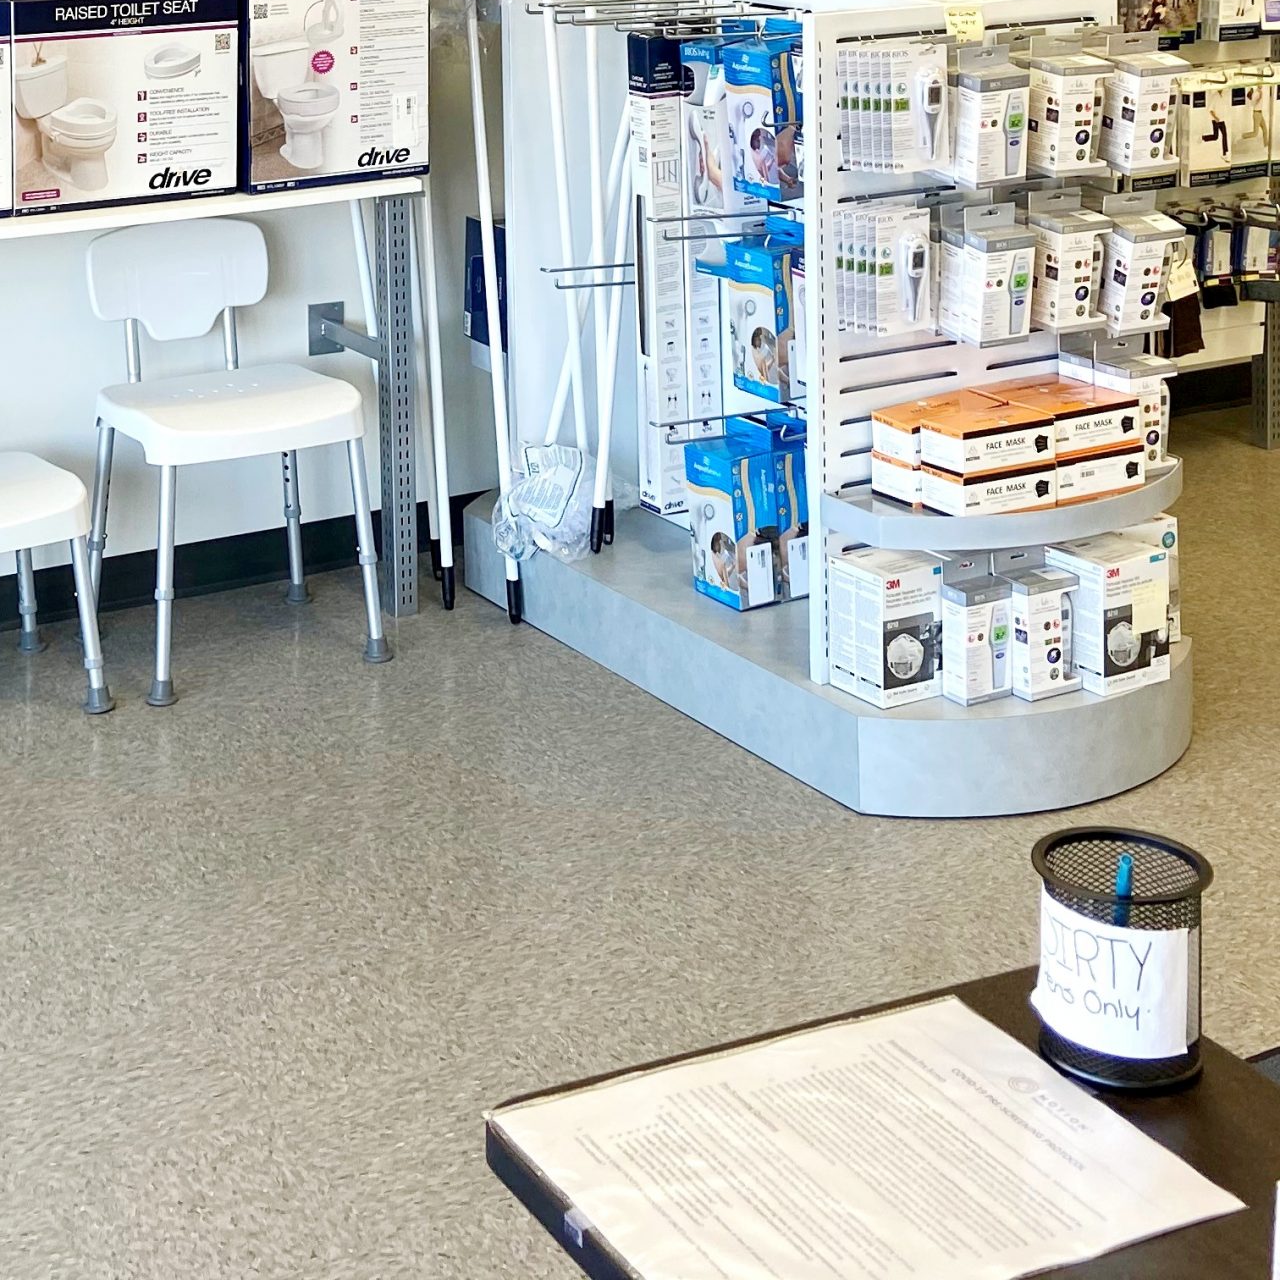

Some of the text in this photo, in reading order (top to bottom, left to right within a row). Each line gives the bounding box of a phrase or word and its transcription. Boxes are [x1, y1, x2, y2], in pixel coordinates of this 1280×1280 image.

[56, 0, 198, 21] RAISED TOILET SEAT
[118, 17, 144, 25] HEIGHT
[892, 50, 909, 59] BIOS
[732, 62, 760, 73] AquaSense
[358, 147, 410, 167] drive
[149, 167, 212, 190] drive
[878, 216, 894, 224] BIOS
[1075, 418, 1113, 432] FACE MASK
[986, 437, 1026, 451] FACE MASK
[986, 482, 1026, 496] FACE MASK
[641, 490, 656, 502] drive
[664, 500, 684, 510] drive
[1106, 568, 1120, 579] 3M
[886, 579, 900, 590] 3M
[951, 1067, 988, 1095] COVID-19
[1039, 1093, 1088, 1132] MOTION
